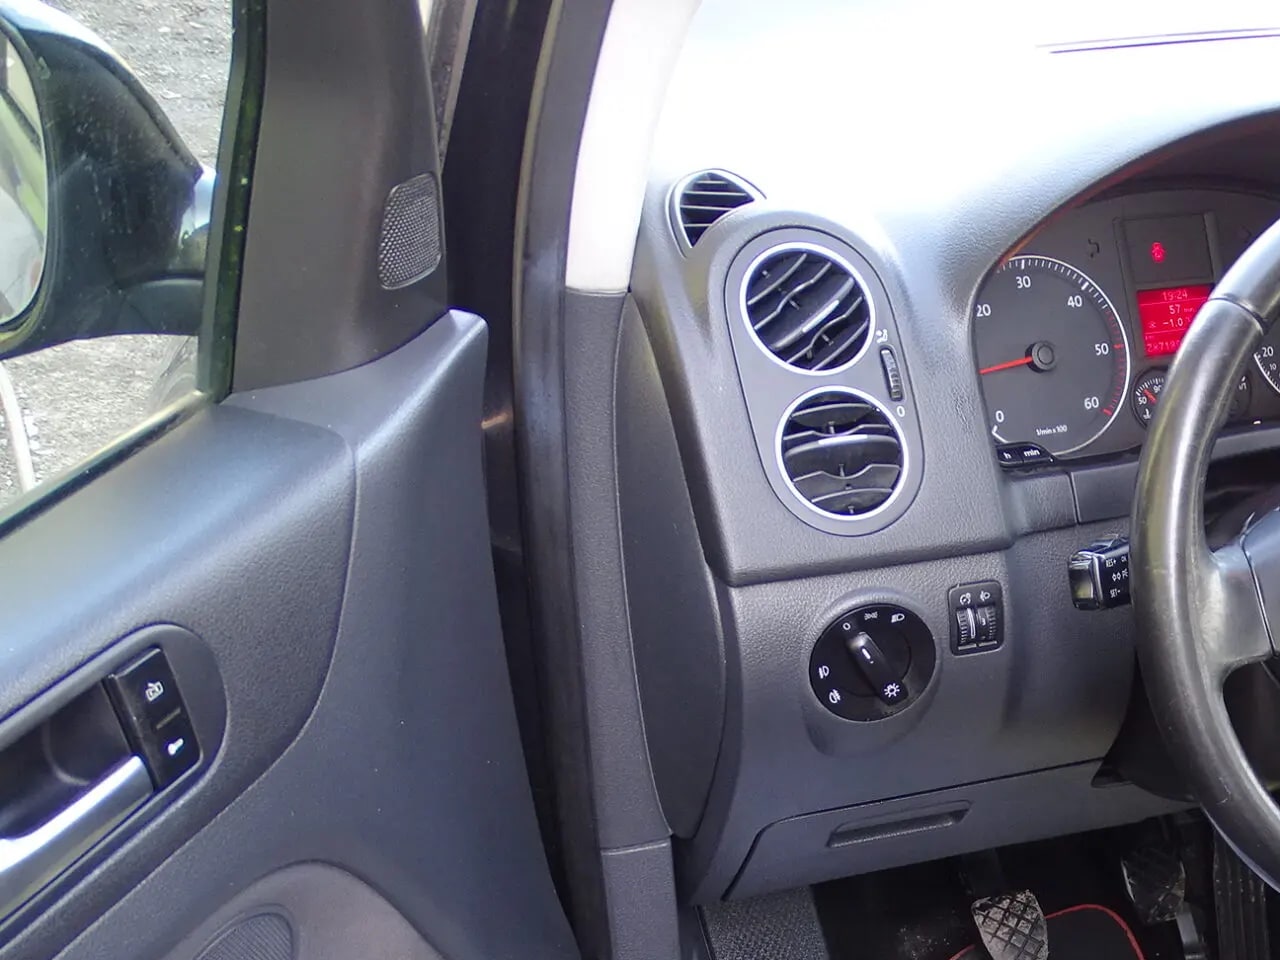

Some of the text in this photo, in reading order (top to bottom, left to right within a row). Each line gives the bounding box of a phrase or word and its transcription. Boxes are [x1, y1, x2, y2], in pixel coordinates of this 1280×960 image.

[1015, 275, 1032, 289] 30
[1067, 295, 1083, 308] 40
[976, 303, 992, 317] 20
[1168, 304, 1181, 315] 57
[1094, 342, 1109, 356] 50
[1261, 346, 1274, 358] 20
[1269, 363, 1277, 371] 10
[1084, 396, 1100, 410] 60
[1137, 396, 1147, 405] 50
[995, 410, 1005, 423] 0
[1023, 449, 1041, 457] min
